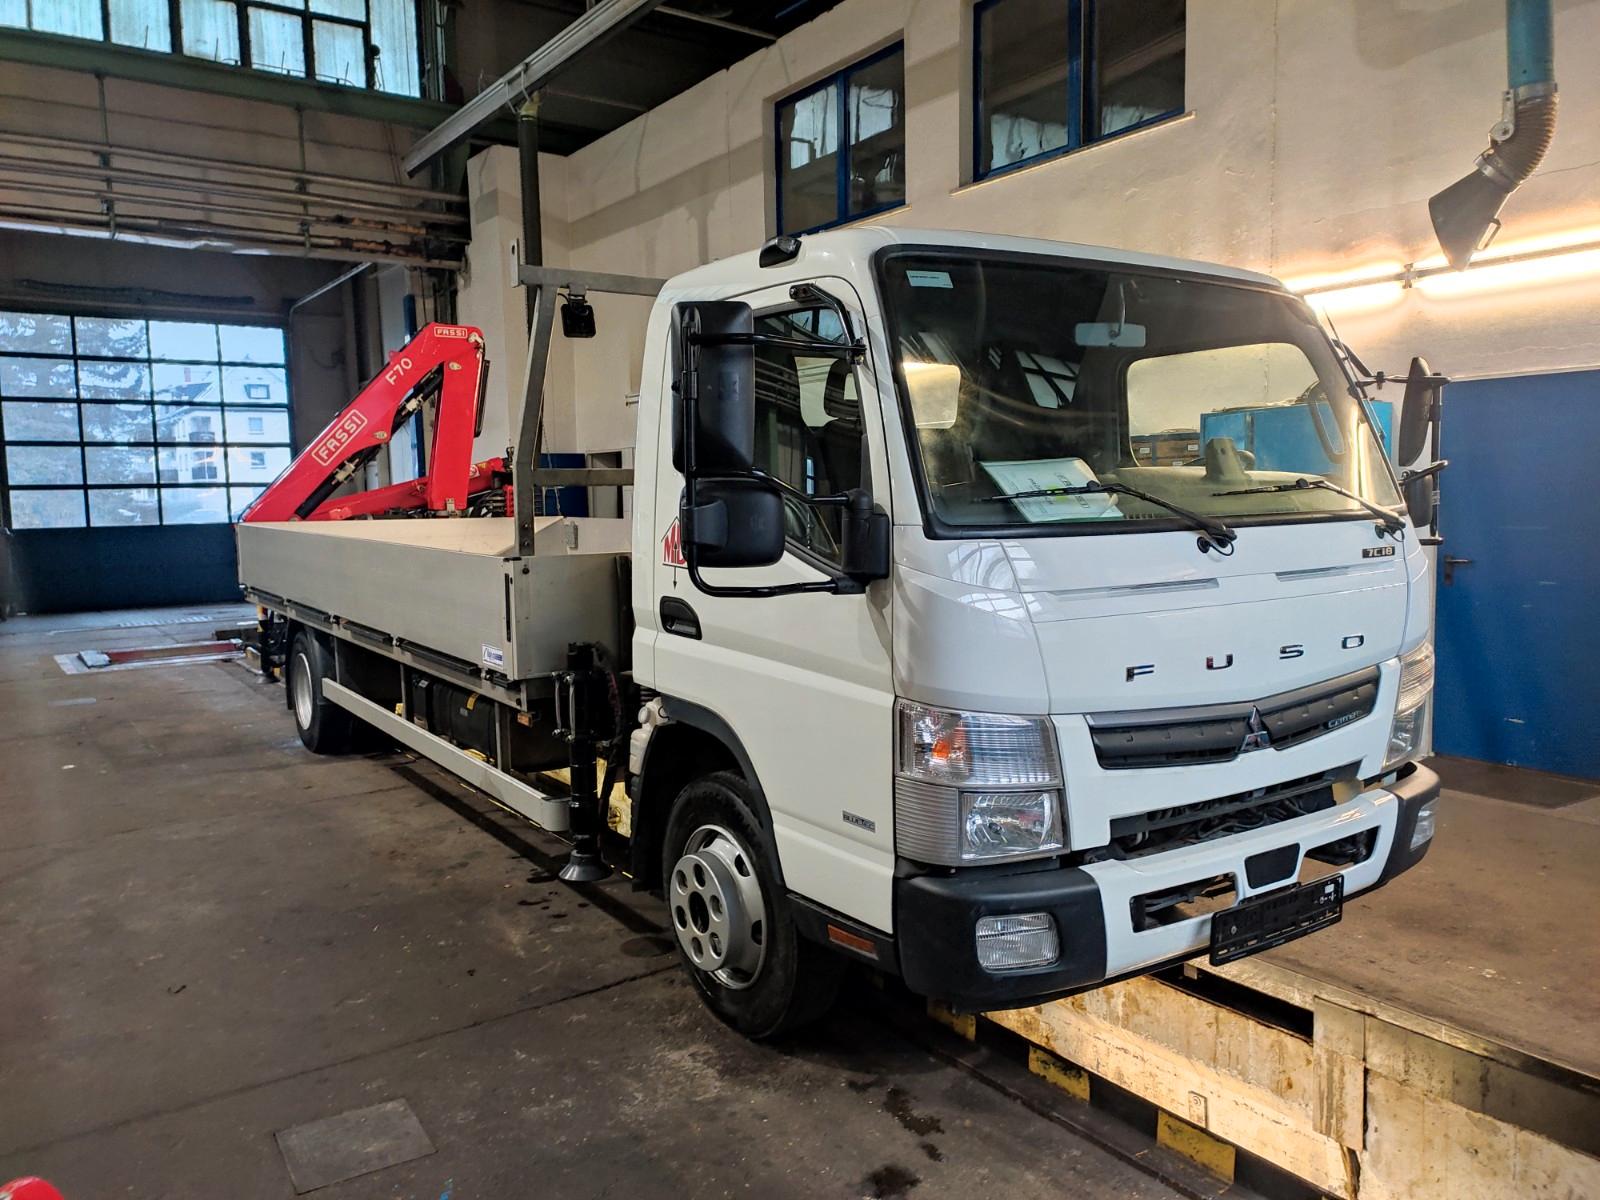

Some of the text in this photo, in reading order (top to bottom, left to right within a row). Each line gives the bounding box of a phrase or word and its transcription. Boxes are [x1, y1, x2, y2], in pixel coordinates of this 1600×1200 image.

[436, 328, 465, 336] FASSI
[385, 358, 413, 385] F70
[318, 415, 363, 460] FASSI
[1366, 546, 1393, 557] 7C18
[1126, 634, 1365, 683] FUSO
